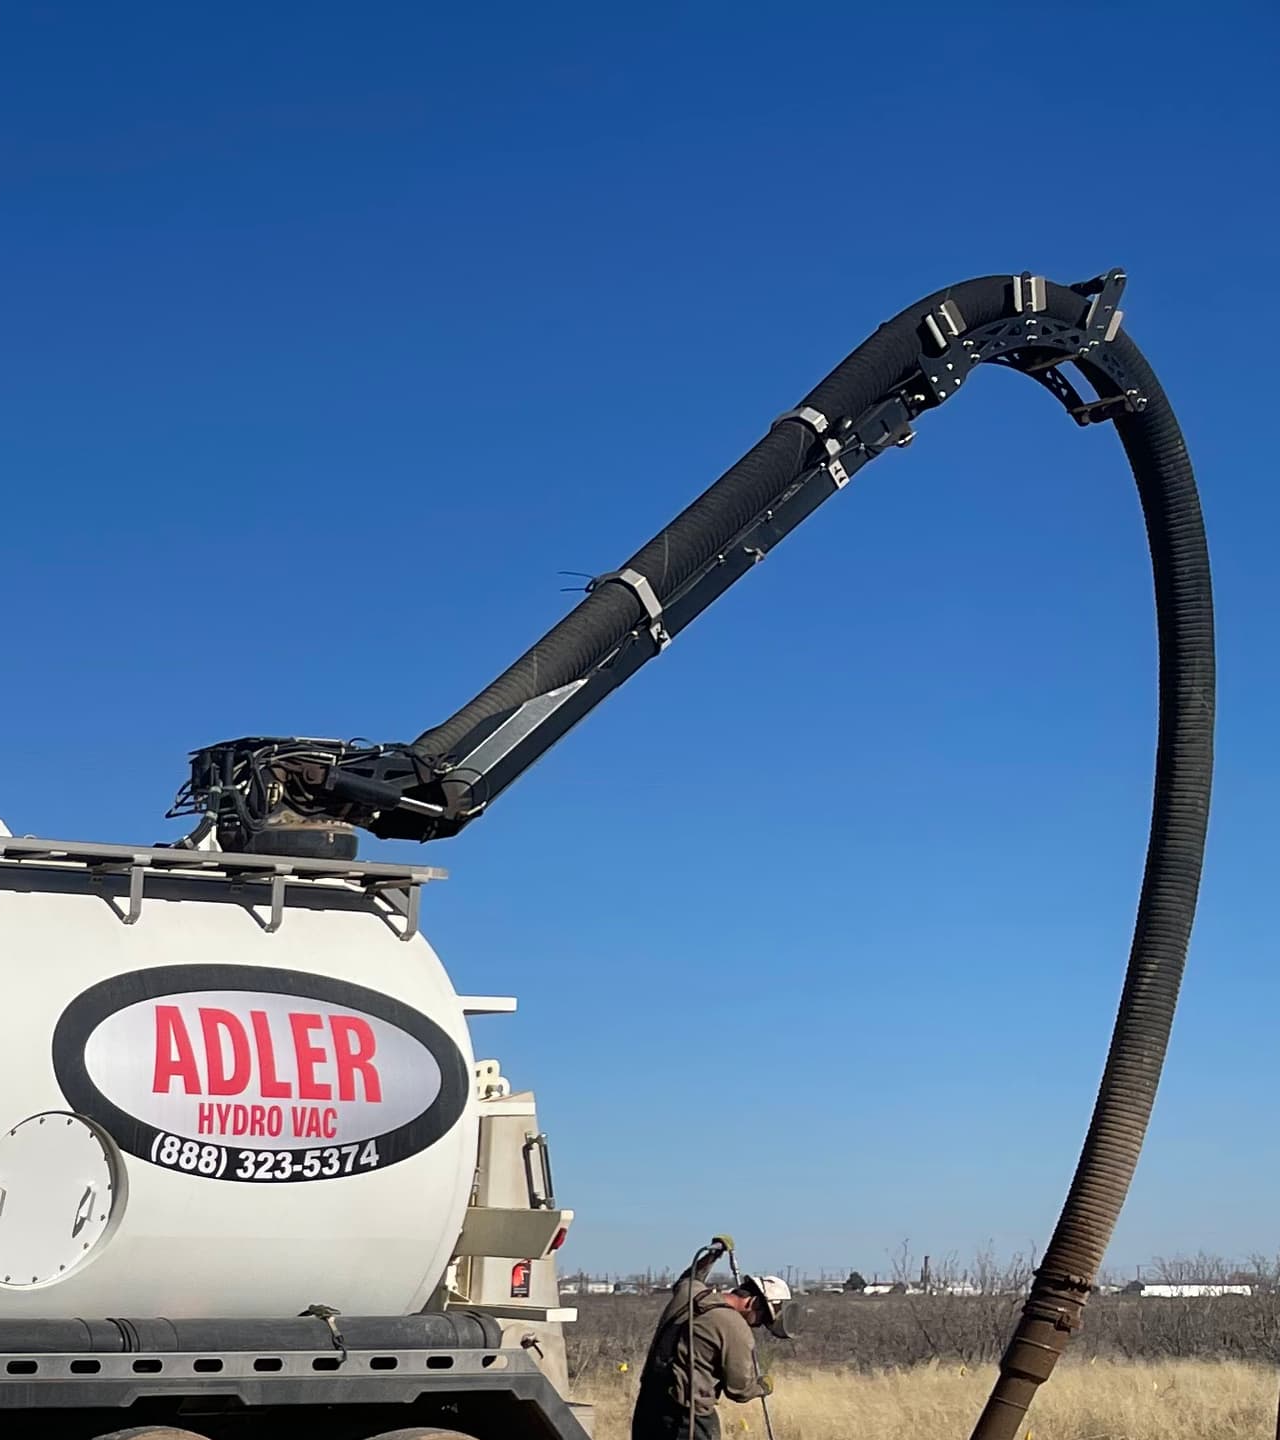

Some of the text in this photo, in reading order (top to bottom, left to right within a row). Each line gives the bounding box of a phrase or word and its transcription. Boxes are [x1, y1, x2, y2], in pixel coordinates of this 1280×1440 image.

[152, 1005, 382, 1103] ADLER
[198, 1102, 338, 1138] HYDRO VAC
[150, 1132, 380, 1180] (888) 323-5374
